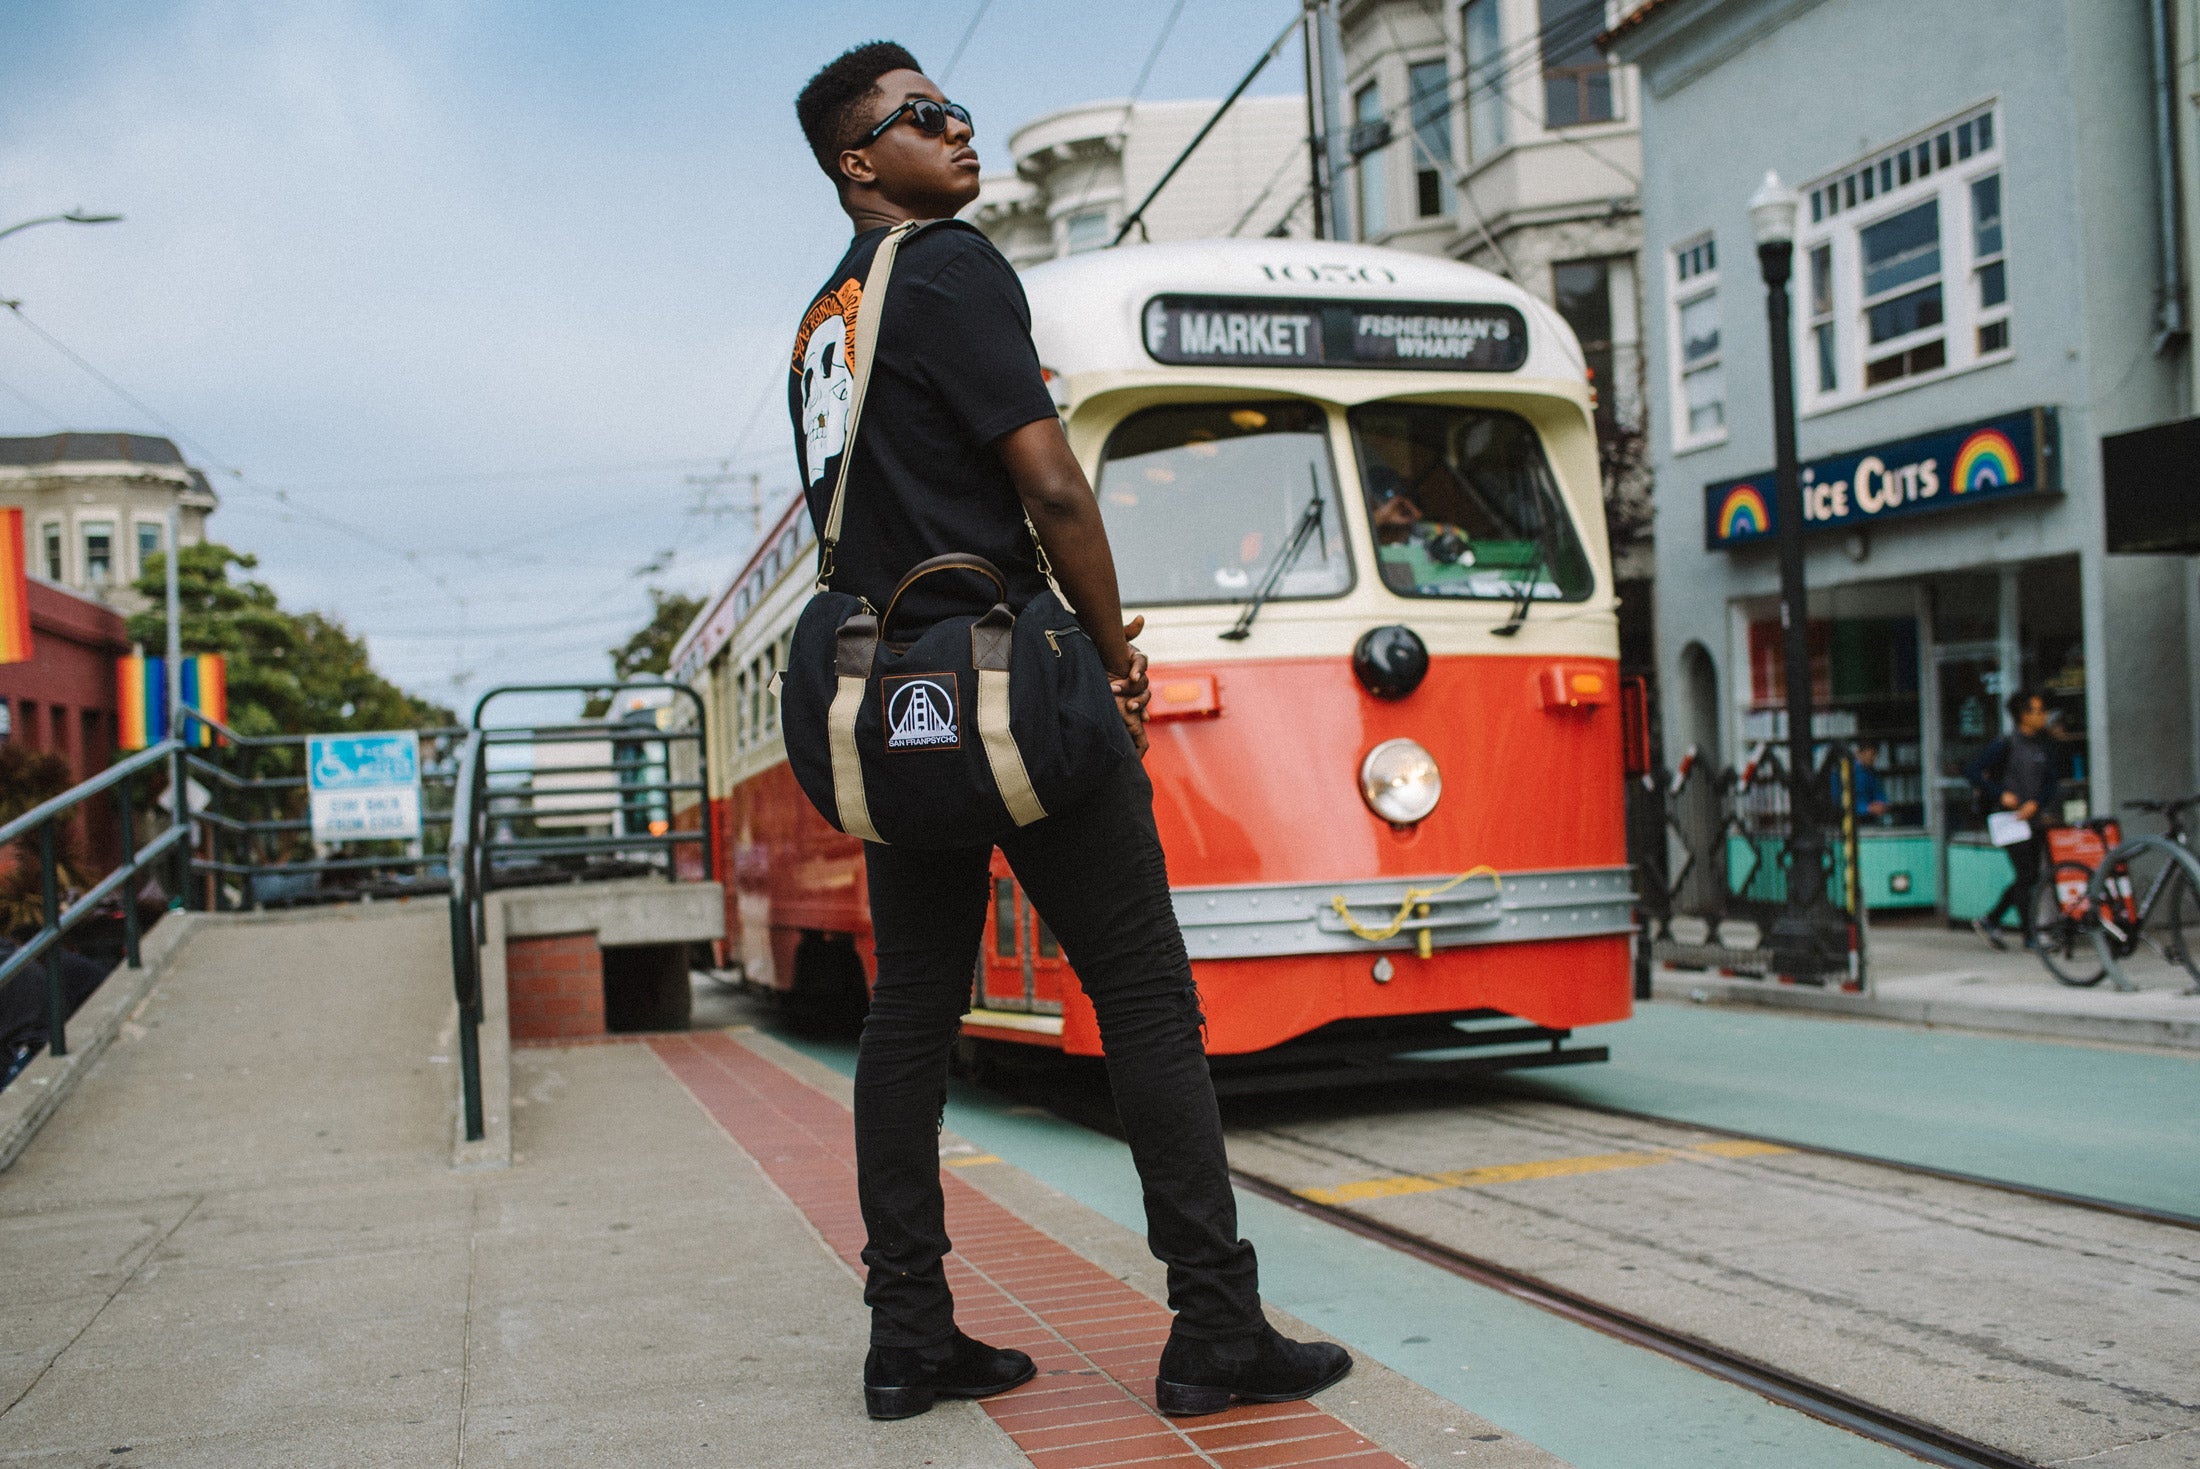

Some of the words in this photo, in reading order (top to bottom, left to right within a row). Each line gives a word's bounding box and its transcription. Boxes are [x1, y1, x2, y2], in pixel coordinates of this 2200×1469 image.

[1259, 263, 1398, 284] 1050
[1146, 308, 1168, 354] F
[1179, 312, 1312, 357] MARKET
[1359, 314, 1511, 341] FISHERMAN'S
[1395, 336, 1477, 360] WHARF
[888, 739, 905, 747] SAN
[906, 736, 959, 746] FRANPSYCHO
